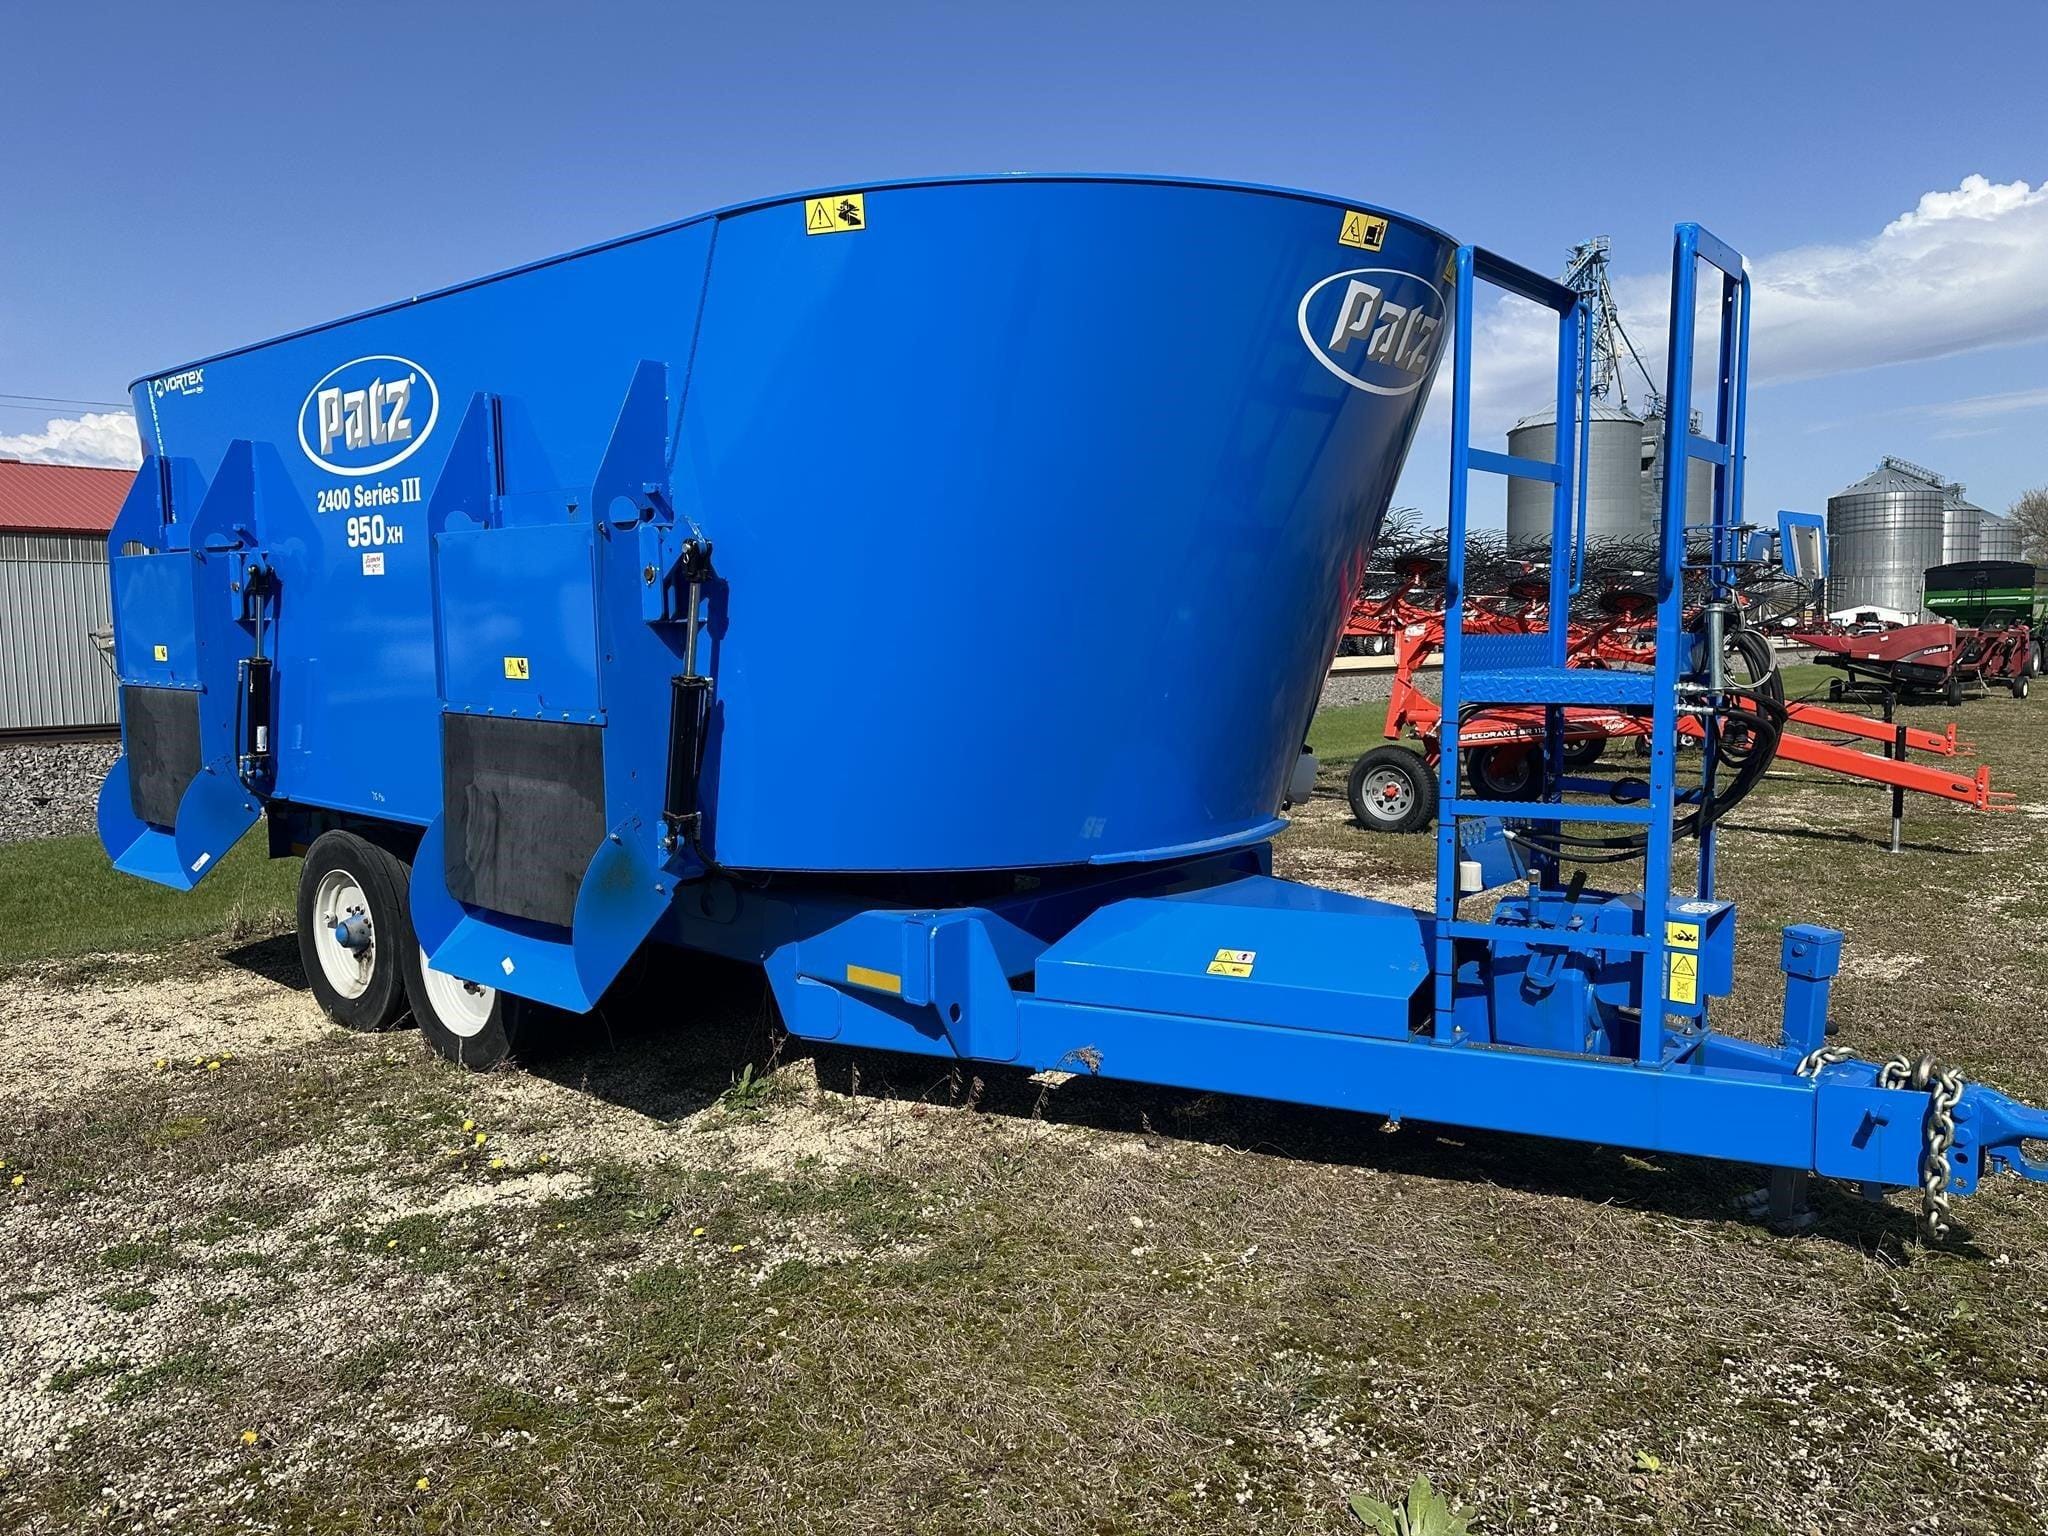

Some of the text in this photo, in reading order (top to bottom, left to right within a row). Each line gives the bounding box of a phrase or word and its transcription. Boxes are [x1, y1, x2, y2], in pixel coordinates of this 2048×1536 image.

[1328, 279, 1440, 375] Patz
[318, 376, 412, 455] Patz
[317, 477, 421, 513] 2400 Series III
[347, 514, 403, 548] 950 XH
[1459, 729, 1517, 741] SPEEDRAKE
